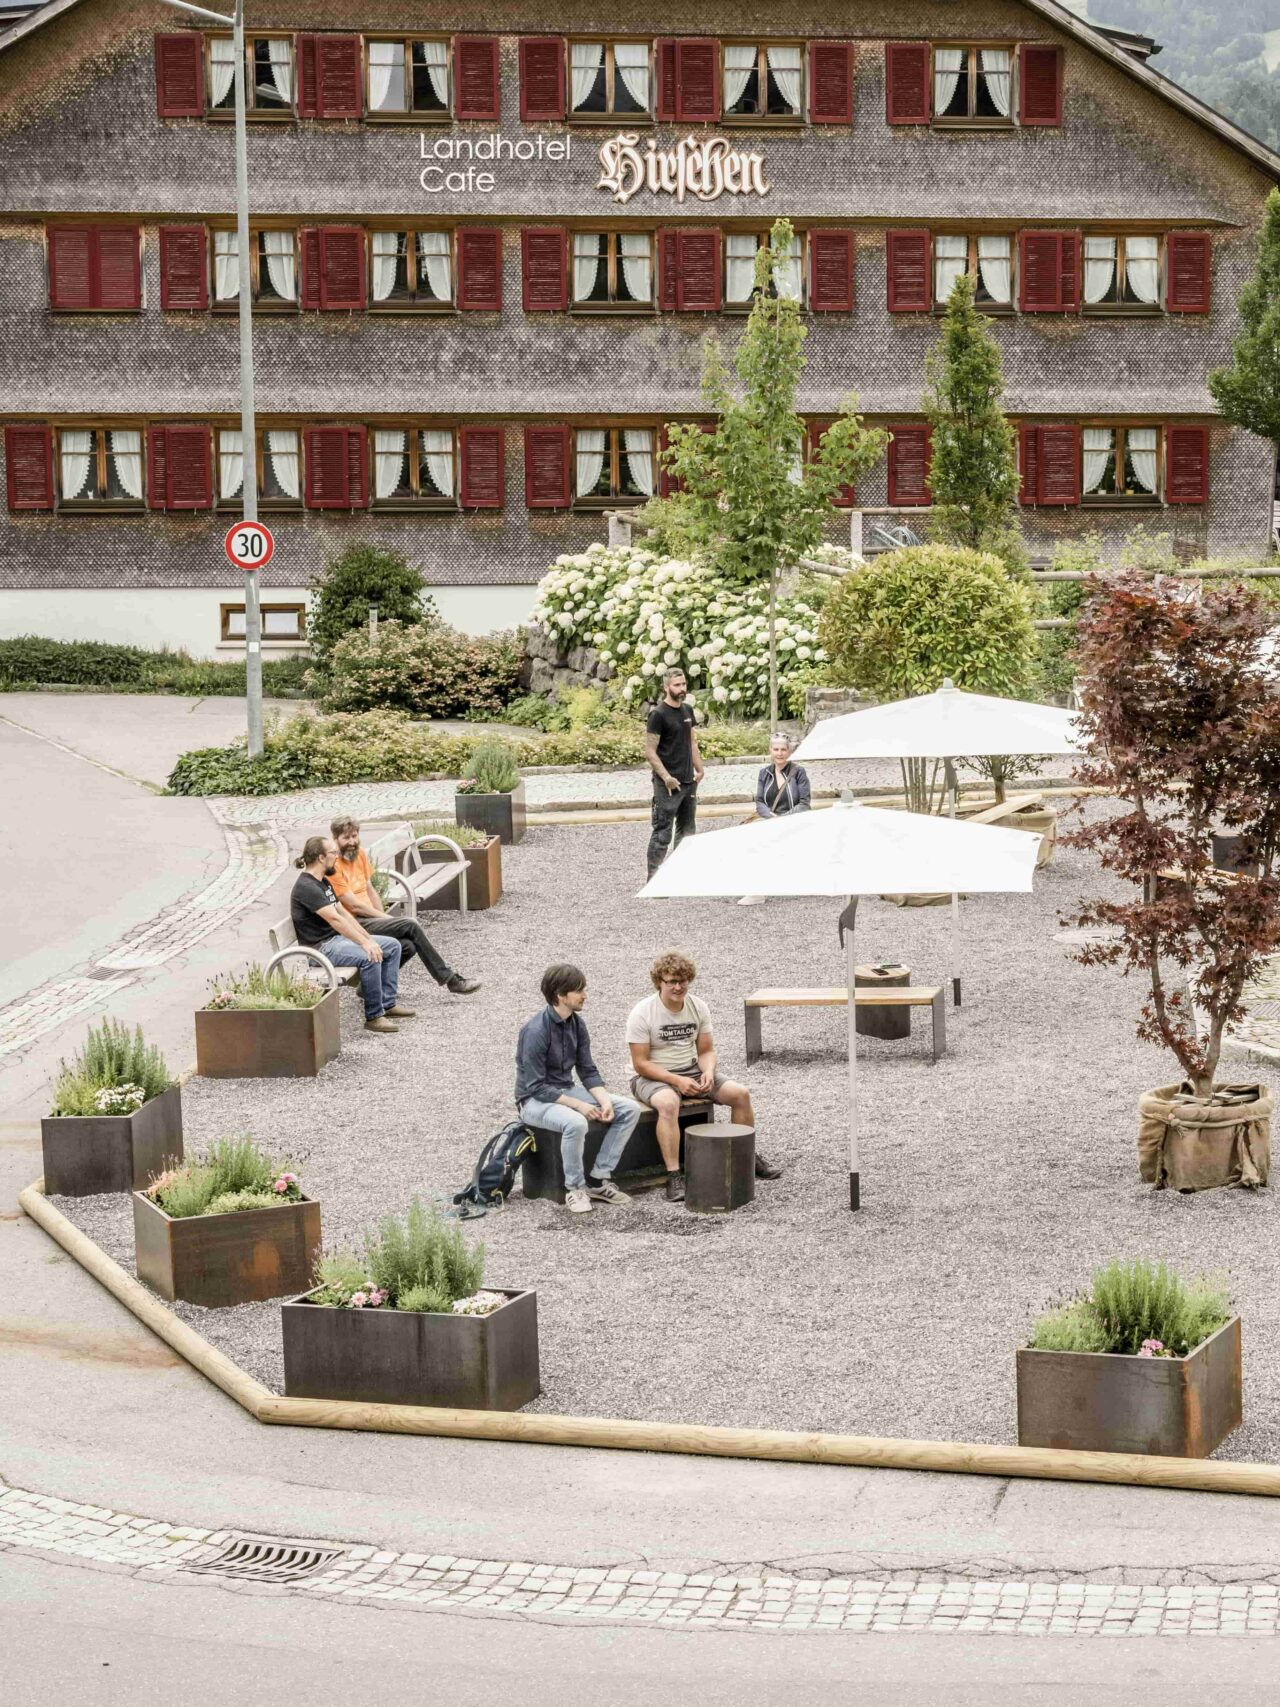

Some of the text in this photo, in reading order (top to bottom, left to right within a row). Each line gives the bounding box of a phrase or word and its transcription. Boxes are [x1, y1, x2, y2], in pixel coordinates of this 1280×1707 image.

[420, 133, 571, 160] Landhotel
[420, 165, 495, 193] Cafe
[595, 132, 772, 204] Hirschen
[237, 533, 263, 558] 30
